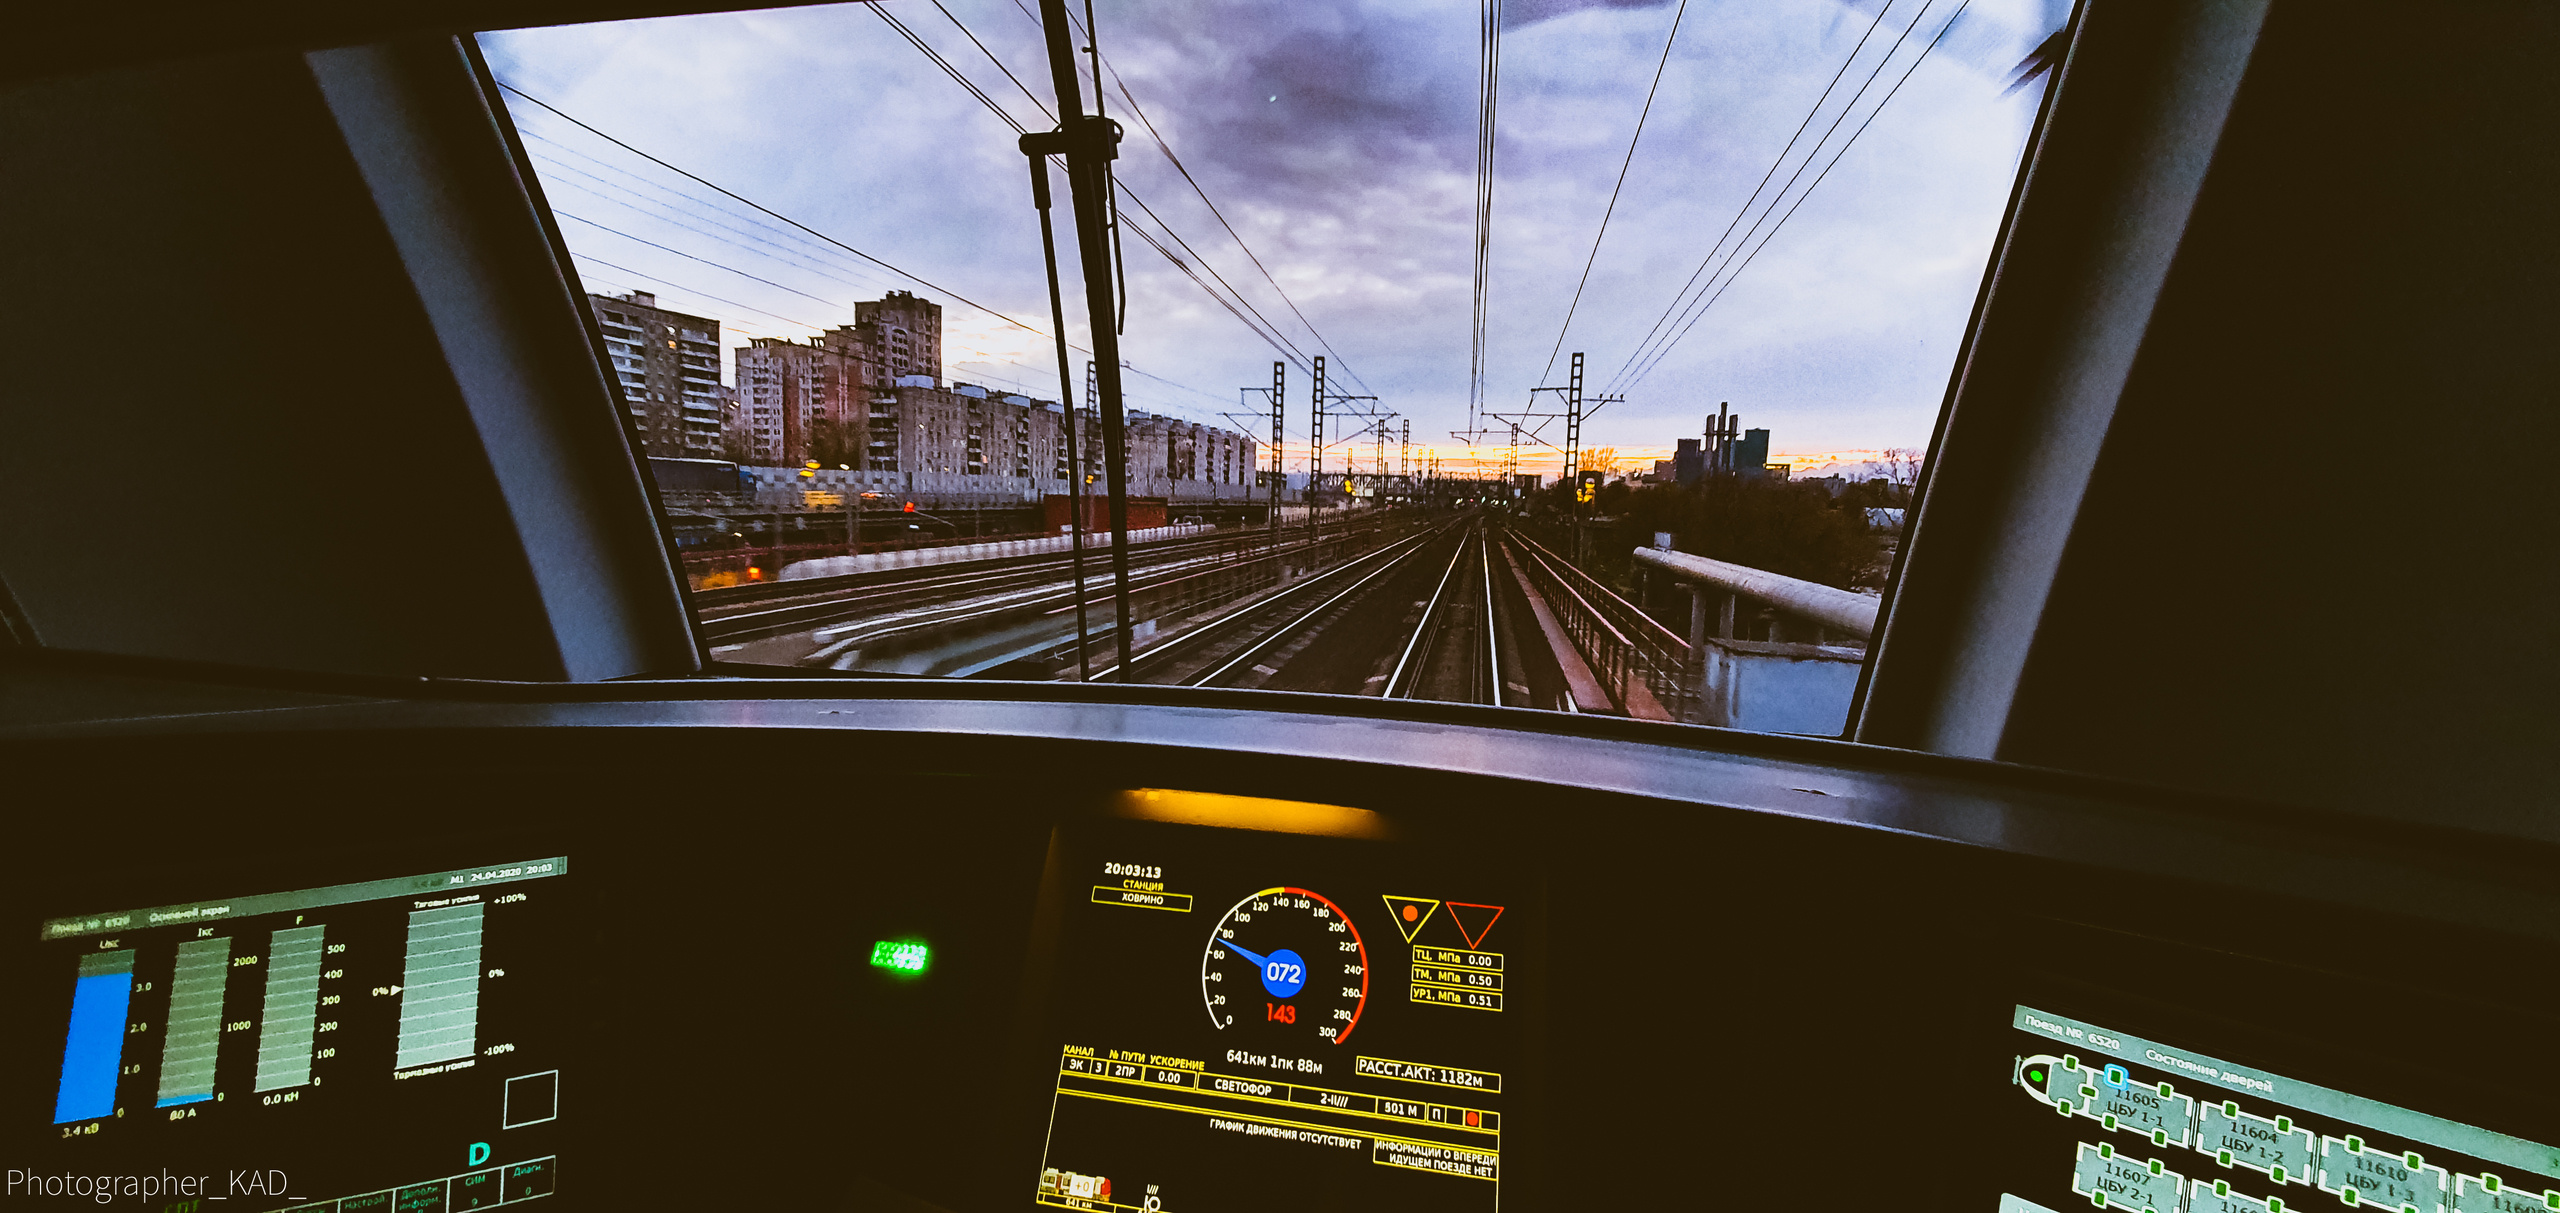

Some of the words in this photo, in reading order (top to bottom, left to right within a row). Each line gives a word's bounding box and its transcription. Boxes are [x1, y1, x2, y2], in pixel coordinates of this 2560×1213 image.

[470, 867, 521, 883] 24.04.2020
[526, 863, 552, 876] 20:03
[1105, 862, 1161, 879] 20:03:13
[1123, 879, 1164, 892] СТАНЦИЯ
[493, 892, 527, 905] +100%
[1121, 892, 1164, 905] ХОВРИНО
[1273, 896, 1289, 908] 140
[1294, 898, 1310, 910] 160
[1252, 900, 1269, 912] 120
[1313, 906, 1330, 919] 180
[1234, 912, 1251, 923] 100
[1328, 921, 1346, 933] 200
[1222, 929, 1234, 940] 80
[327, 943, 346, 955] 500
[1339, 941, 1357, 953] 220
[233, 955, 258, 968] 2000
[1213, 949, 1225, 961] 60
[1438, 951, 1460, 963] МПа
[1468, 954, 1492, 967] 0.00
[324, 969, 343, 981] 400
[488, 969, 505, 979] 0%
[1266, 961, 1301, 985] 072
[1344, 964, 1362, 976] 240
[1210, 972, 1222, 983] 40
[1438, 970, 1460, 983] МПа
[1468, 974, 1492, 987] 0.50
[372, 986, 389, 997] 0%
[1342, 987, 1360, 998] 260
[321, 994, 341, 1006] 300
[1214, 994, 1226, 1006] 20
[1438, 990, 1460, 1003] МПа
[1468, 994, 1492, 1007] 0.51
[1225, 1014, 1234, 1026] 0
[1266, 1002, 1296, 1025] 143
[1333, 1008, 1351, 1020] 280
[130, 1022, 148, 1034] 2.0
[227, 1020, 251, 1033] 1000
[319, 1021, 338, 1033] 200
[1319, 1026, 1337, 1038] 300
[2025, 1014, 2063, 1036] Поезд
[2088, 1033, 2120, 1051] 6520
[317, 1047, 336, 1059] 100
[483, 1043, 515, 1056] -100%
[1064, 1044, 1095, 1057] КАНАЛ
[1120, 1050, 1146, 1063] ПУТИ
[1150, 1054, 1206, 1072] УСКОРЕНИЕ
[1226, 1049, 1267, 1067] 641км
[1270, 1055, 1293, 1071] 1пк
[1297, 1058, 1323, 1075] 88м
[123, 1064, 141, 1075] 1.0
[1069, 1058, 1083, 1071] ЭК
[2145, 1048, 2219, 1079] Состояние
[2220, 1073, 2274, 1093] дверей
[1115, 1065, 1136, 1078] 2ПР
[1158, 1070, 1181, 1084] 0.00
[1358, 1059, 1436, 1082] РАССТ.АКТ:
[1440, 1069, 1483, 1088] 1182м
[313, 1076, 321, 1087] 0
[1214, 1078, 1272, 1097] СВЕТОФОР
[217, 1092, 225, 1102] 0
[262, 1093, 282, 1106] 0.0
[2114, 1088, 2160, 1110] 11605
[1432, 1108, 1441, 1121] П
[2106, 1100, 2137, 1118] ЦБУ
[2142, 1111, 2163, 1127] 1-1
[1209, 1118, 1245, 1133] ГРАФИК
[1245, 1124, 1298, 1141] ДВИЖЕНИЯ
[1299, 1131, 1362, 1150] ОТСУТСТВУЕТ
[2229, 1121, 2278, 1144] 11604
[468, 1141, 492, 1167] D
[1375, 1140, 1441, 1158] ИНФОРМАЦИИ
[1443, 1149, 1451, 1159] О
[1453, 1150, 1497, 1166] ВПЕРЕДИ
[2221, 1135, 2254, 1153] ЦБУ
[2259, 1146, 2284, 1164] 1-2
[1389, 1153, 1432, 1169] ИДУЩЕМ
[1433, 1159, 1472, 1175] ПОЕЗДЕ
[1474, 1165, 1493, 1177] НЕТ
[2355, 1156, 2408, 1182] 11610
[2105, 1162, 2150, 1185] 11607
[2346, 1172, 2381, 1191] ЦБУ
[2096, 1176, 2127, 1194] ЦБУ
[2131, 1187, 2153, 1205] 2-1
